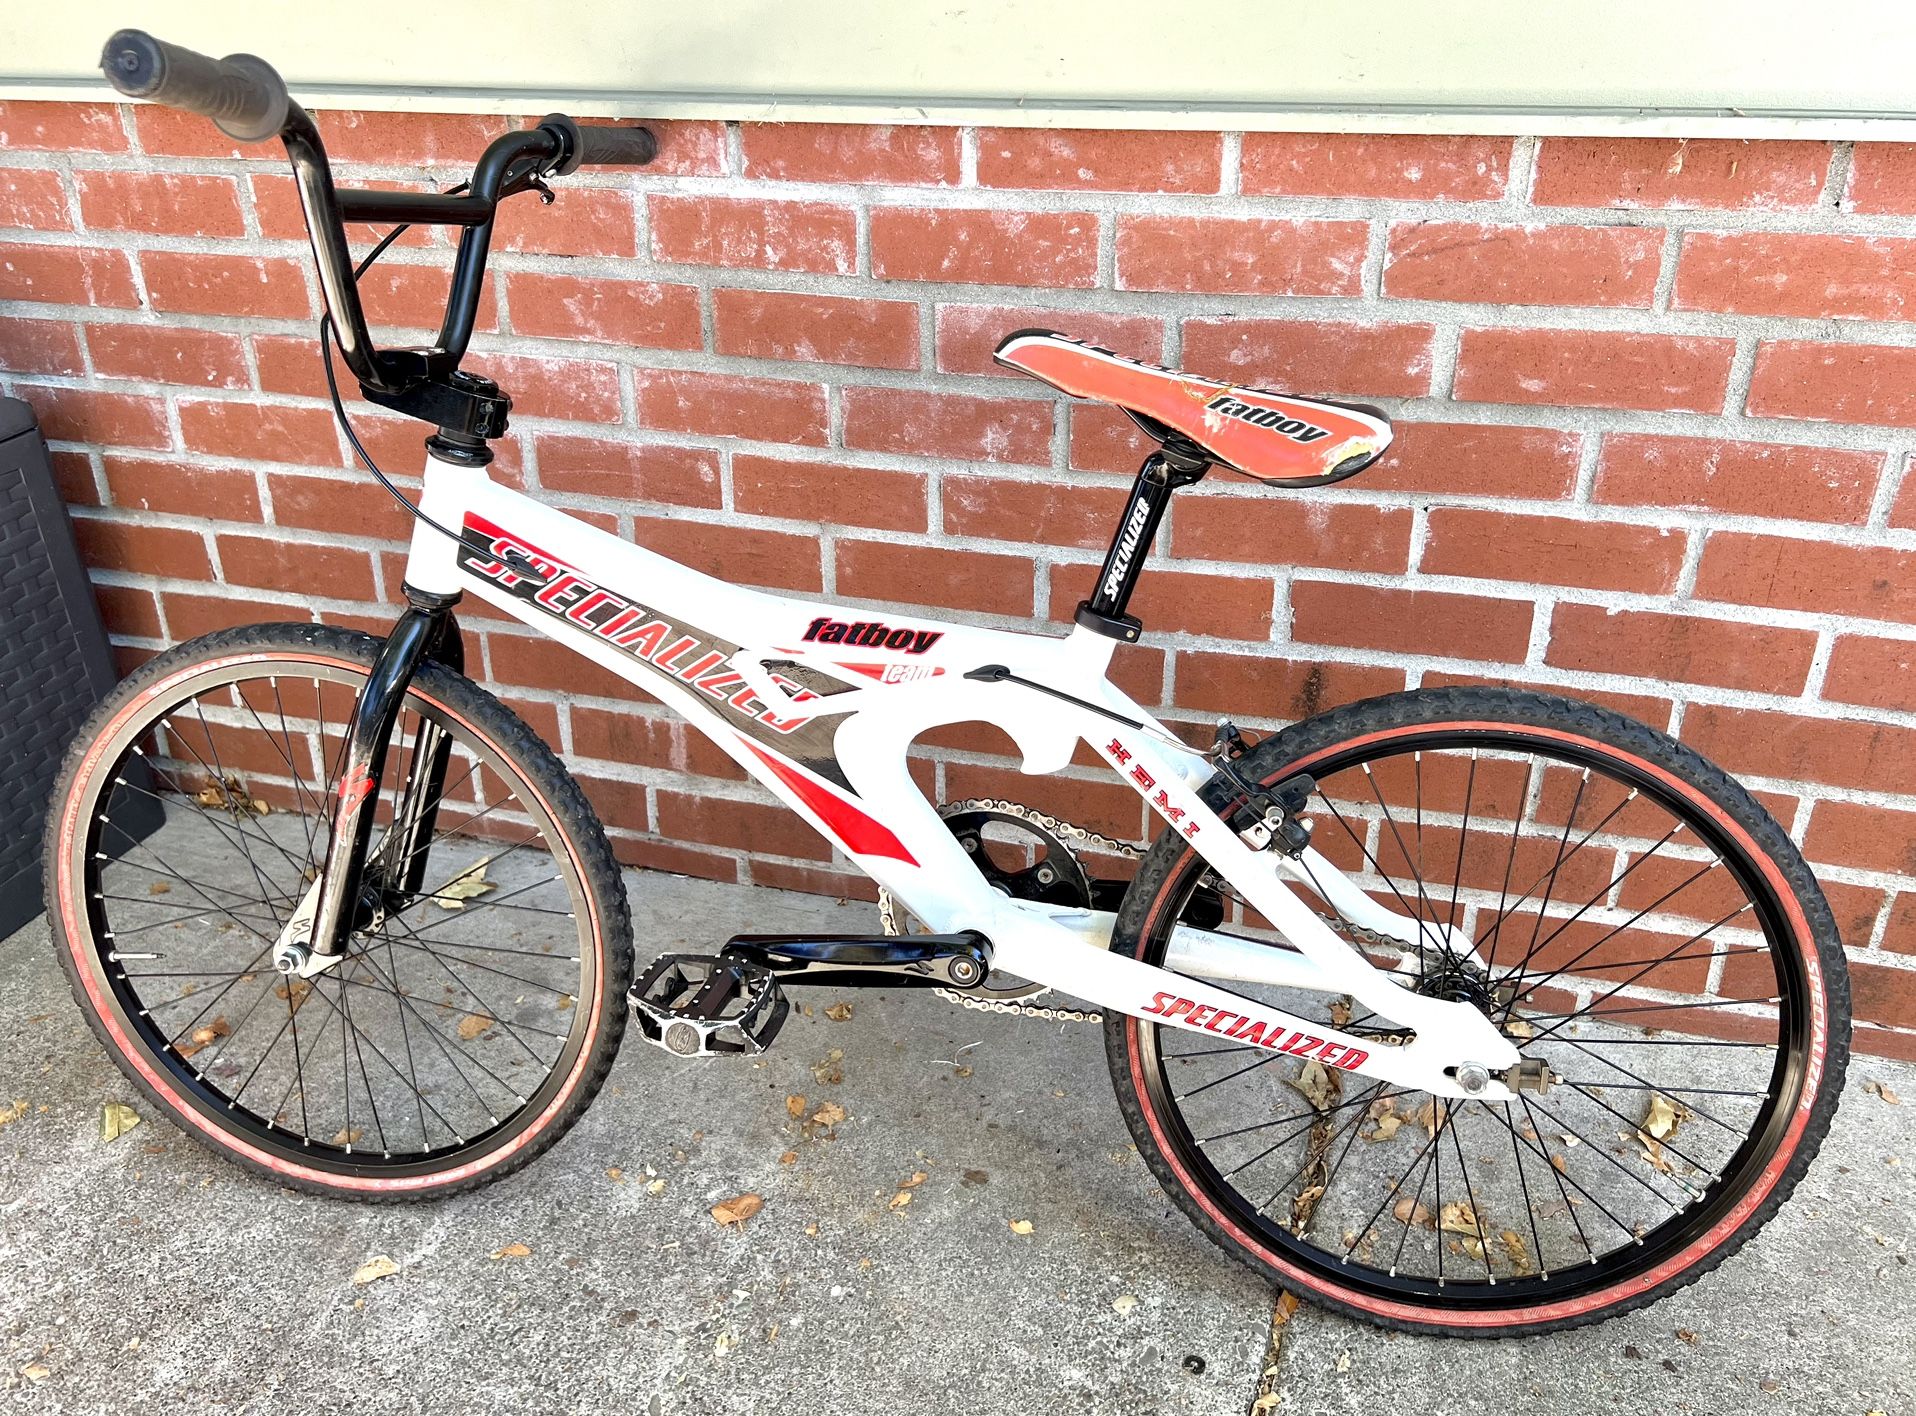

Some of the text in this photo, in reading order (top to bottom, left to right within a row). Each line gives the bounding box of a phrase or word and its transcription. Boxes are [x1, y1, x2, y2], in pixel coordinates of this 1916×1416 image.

[1205, 396, 1332, 442] fatboy
[801, 617, 945, 655] fatboy
[1106, 738, 1201, 839] HEMI
[1141, 991, 1369, 1071] SPECIALIZED
